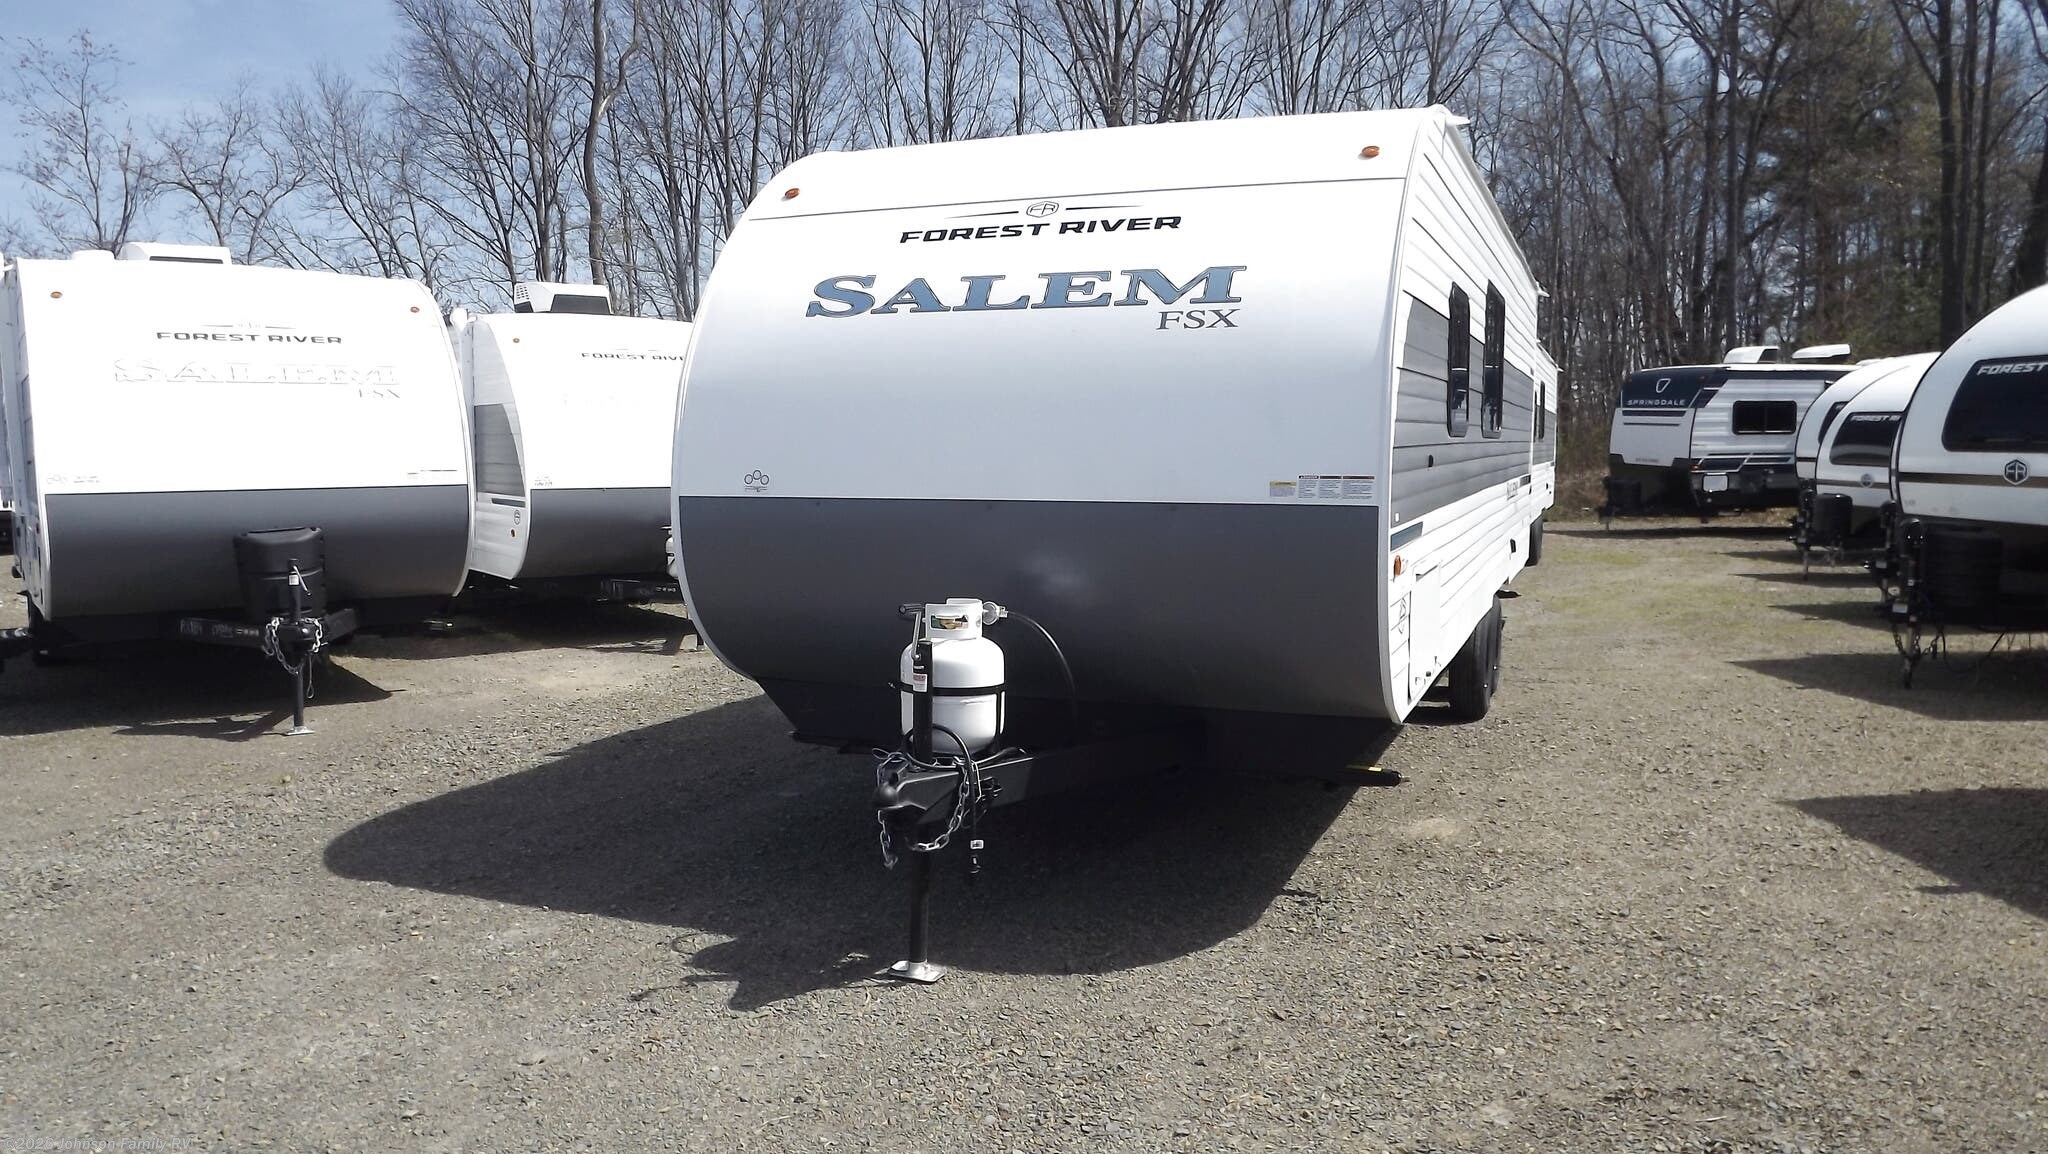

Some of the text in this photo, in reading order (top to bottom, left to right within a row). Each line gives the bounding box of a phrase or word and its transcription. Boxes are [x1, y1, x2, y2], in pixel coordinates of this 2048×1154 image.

[899, 216, 1182, 244] FOREST RIVER
[805, 265, 1248, 319] SALEM
[1155, 308, 1241, 331] FSX
[156, 332, 342, 344] FOREST RIVER
[581, 352, 646, 360] FOREST
[1977, 362, 2048, 376] FOREST
